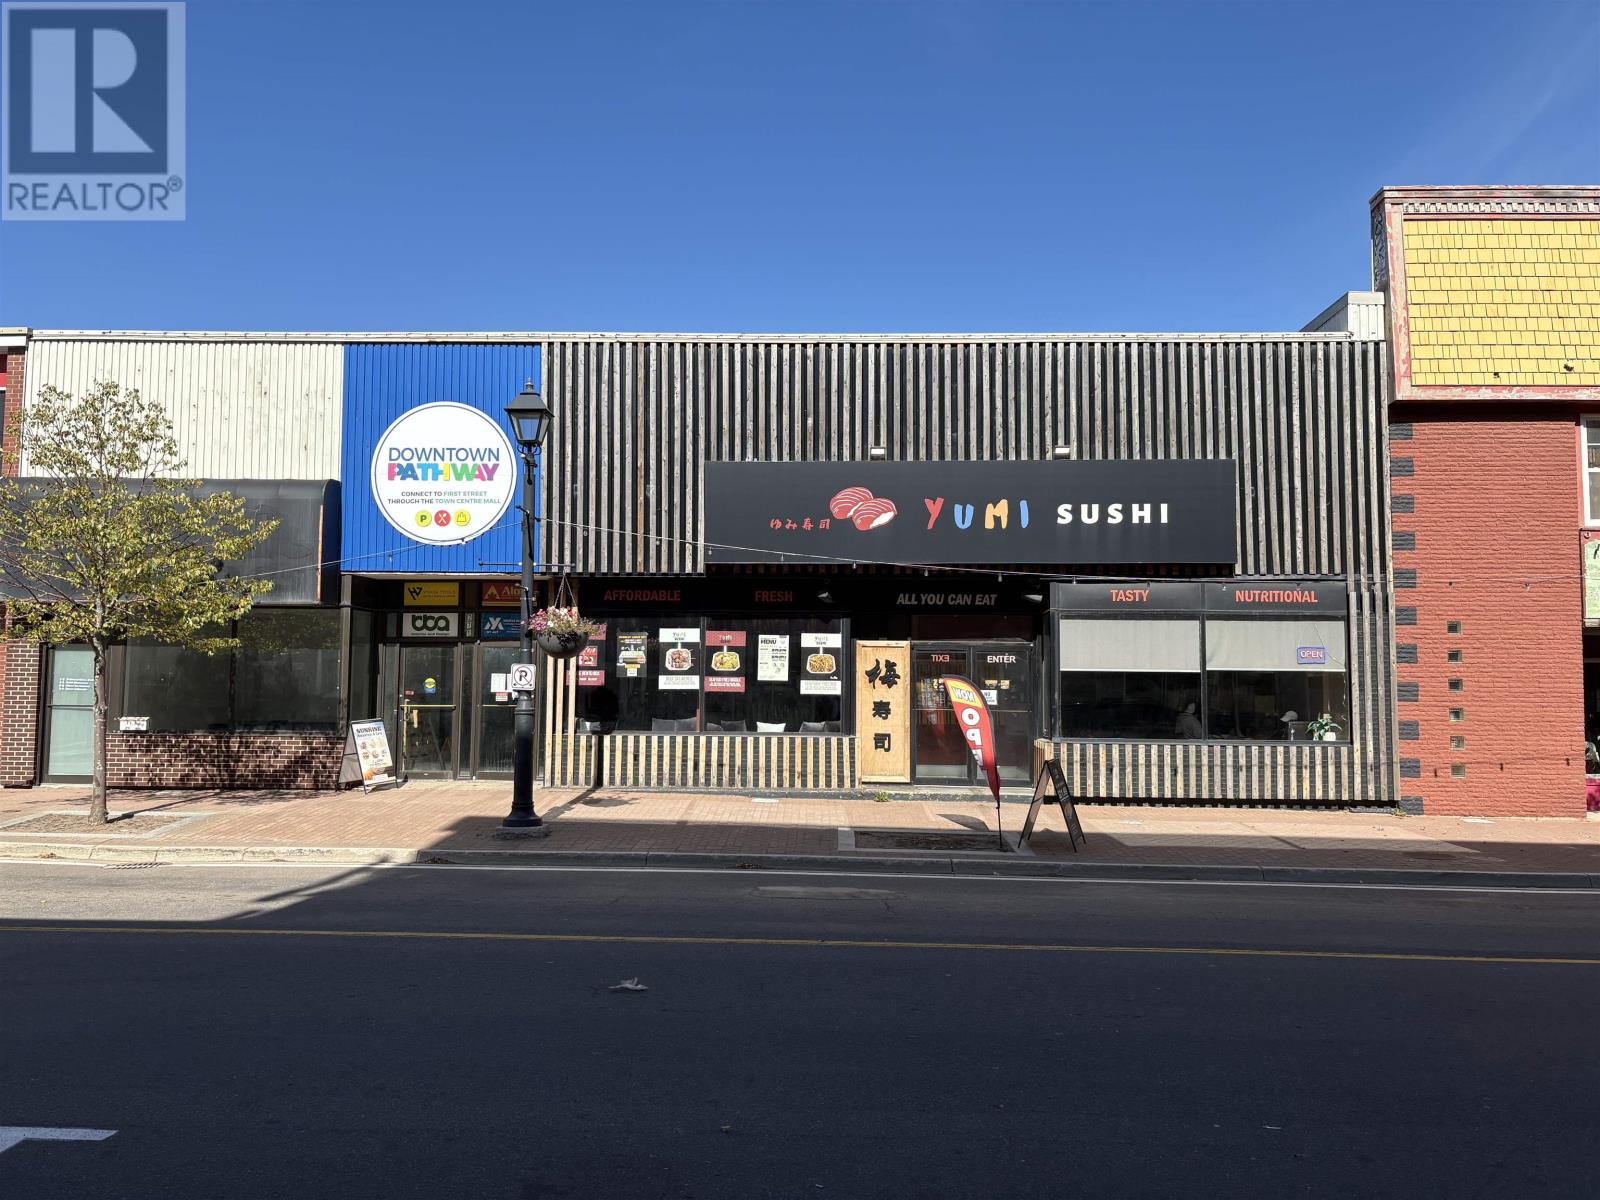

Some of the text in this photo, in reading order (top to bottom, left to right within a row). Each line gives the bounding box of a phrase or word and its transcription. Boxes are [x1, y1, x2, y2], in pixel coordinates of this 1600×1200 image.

[388, 447, 500, 462] DOWNTOWN
[387, 462, 500, 481] PATHWAY
[924, 498, 1169, 530] YUMI SUSHI
[604, 589, 681, 602] AFFORDABLE
[754, 590, 793, 602] FRESH
[896, 593, 998, 606] ALL YOU CAN EAT
[1110, 589, 1149, 602] TASTY
[1235, 589, 1319, 603] NUTRITIONAL
[987, 655, 1017, 664] ENTER
[1300, 649, 1323, 659] OPEN
